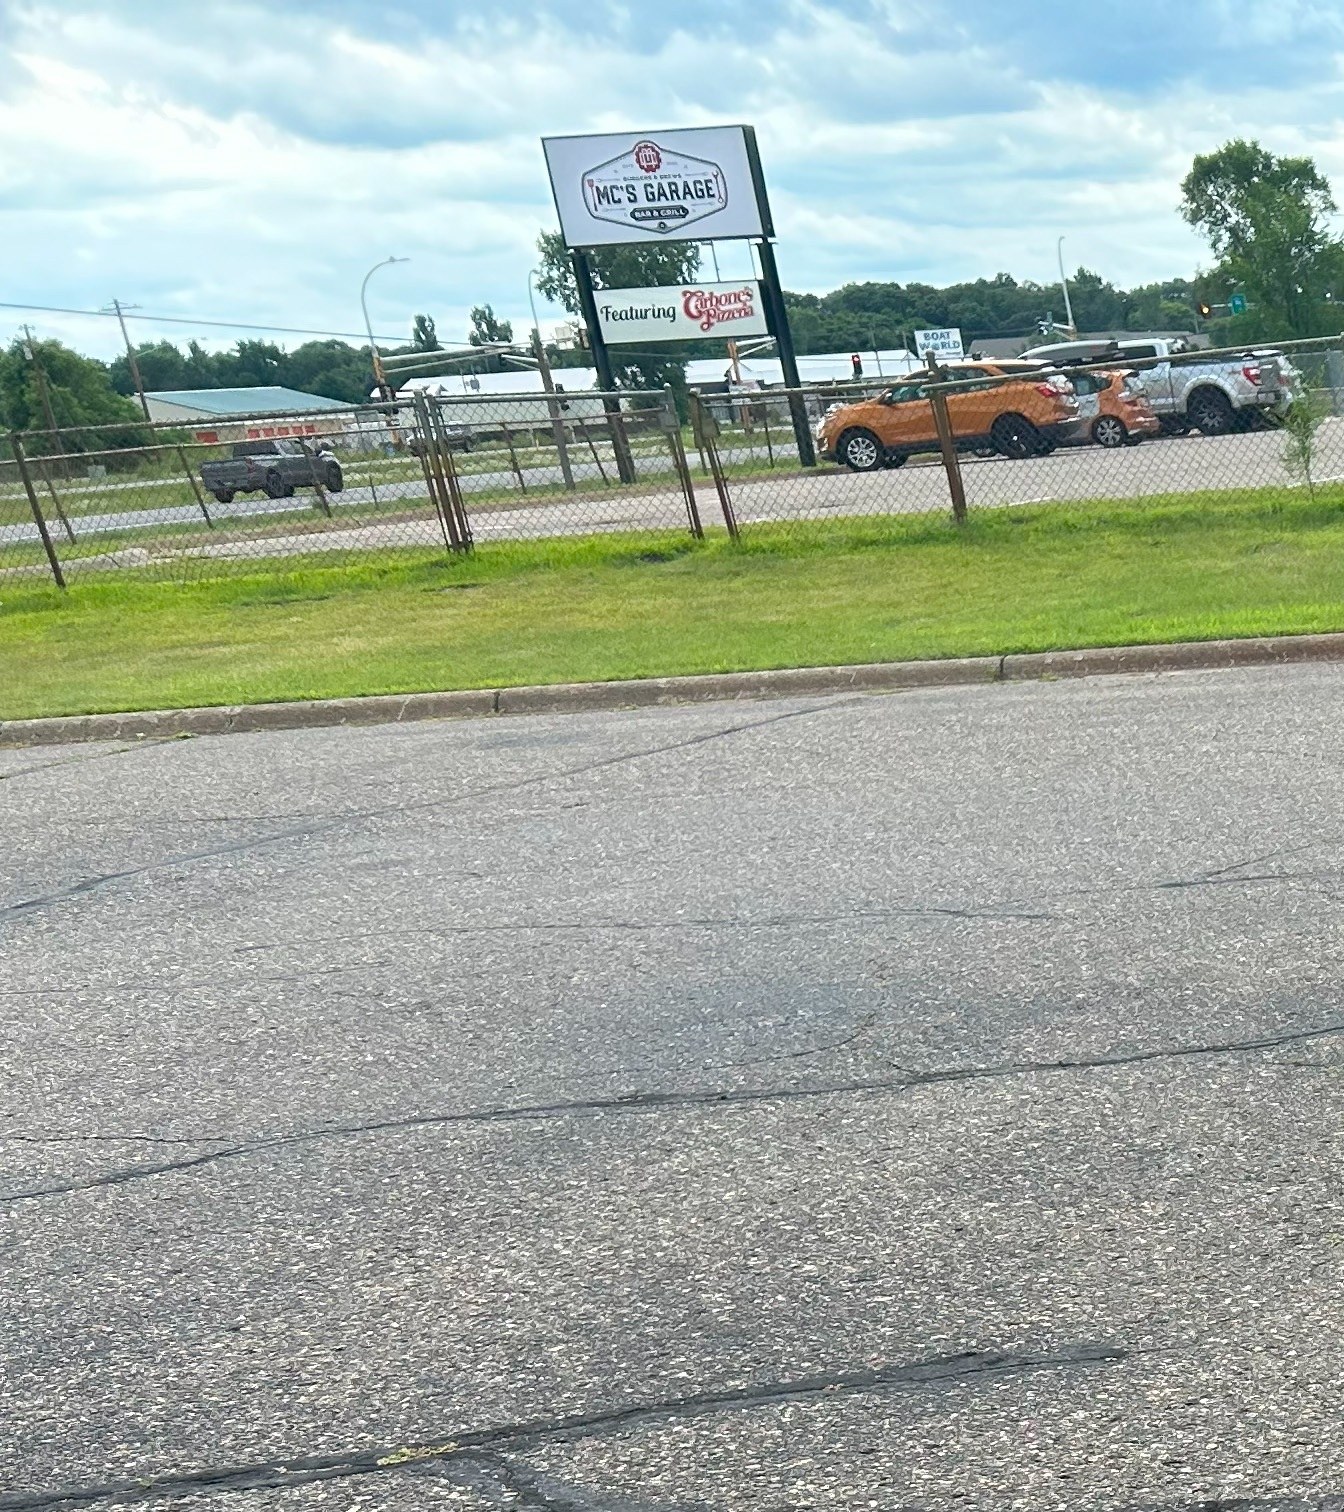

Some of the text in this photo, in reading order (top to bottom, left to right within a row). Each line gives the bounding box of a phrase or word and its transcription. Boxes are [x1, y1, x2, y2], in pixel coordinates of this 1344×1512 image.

[595, 179, 716, 205] MC'S GARAGE
[634, 208, 686, 218] BAR & GRILL
[600, 304, 676, 323] Featuring
[923, 331, 951, 341] BOAT
